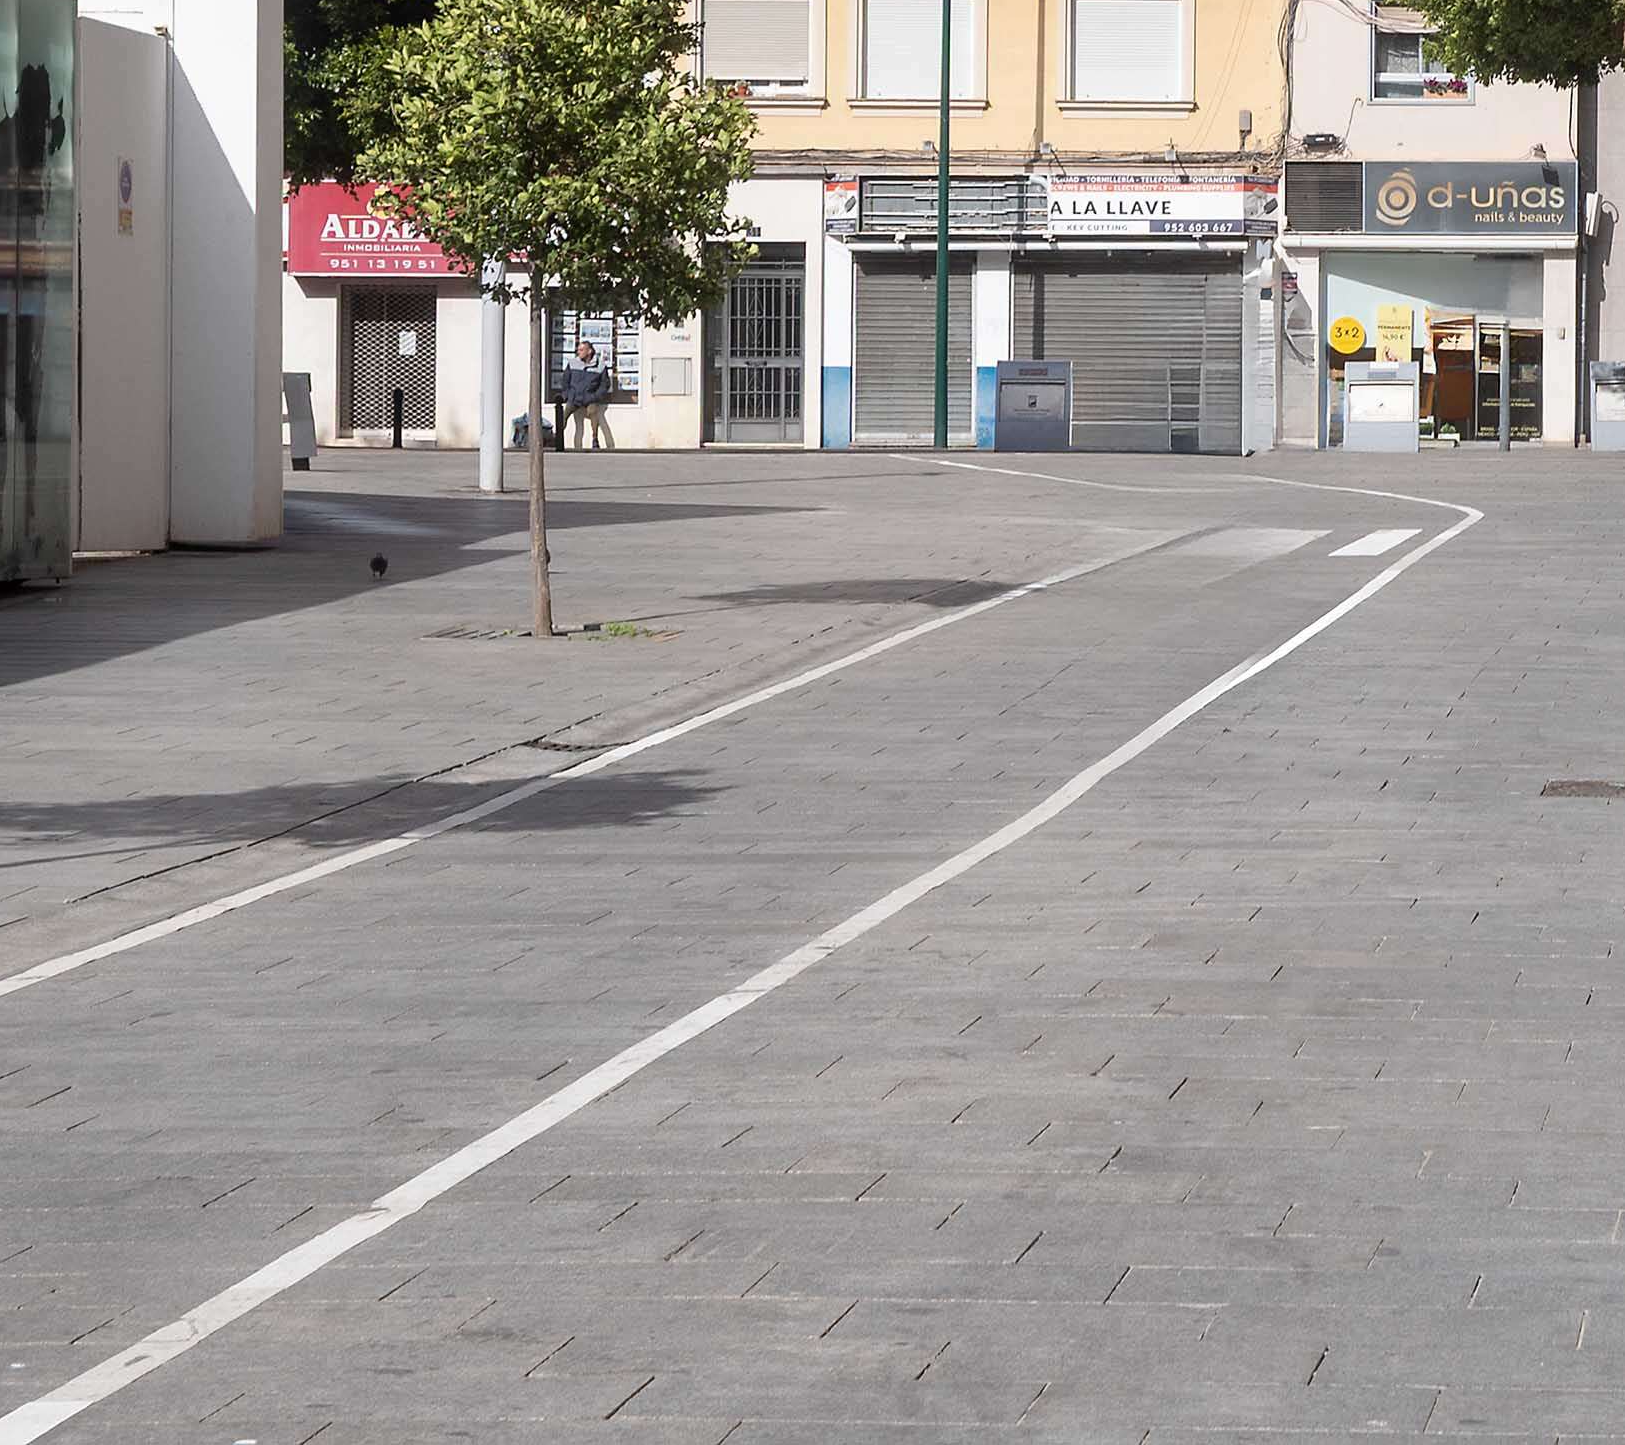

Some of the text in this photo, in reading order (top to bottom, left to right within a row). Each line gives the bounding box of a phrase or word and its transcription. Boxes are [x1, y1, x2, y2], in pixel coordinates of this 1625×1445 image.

[1427, 181, 1565, 209] d-uñas
[1050, 200, 1172, 215] A LA LLAVE
[1474, 211, 1565, 225] nails & beauty
[1164, 222, 1184, 232] 952
[1188, 222, 1209, 232] 603
[1212, 222, 1233, 232] 667
[343, 243, 421, 252] INMOBILIARIA
[329, 258, 437, 269] 951 13 19 51
